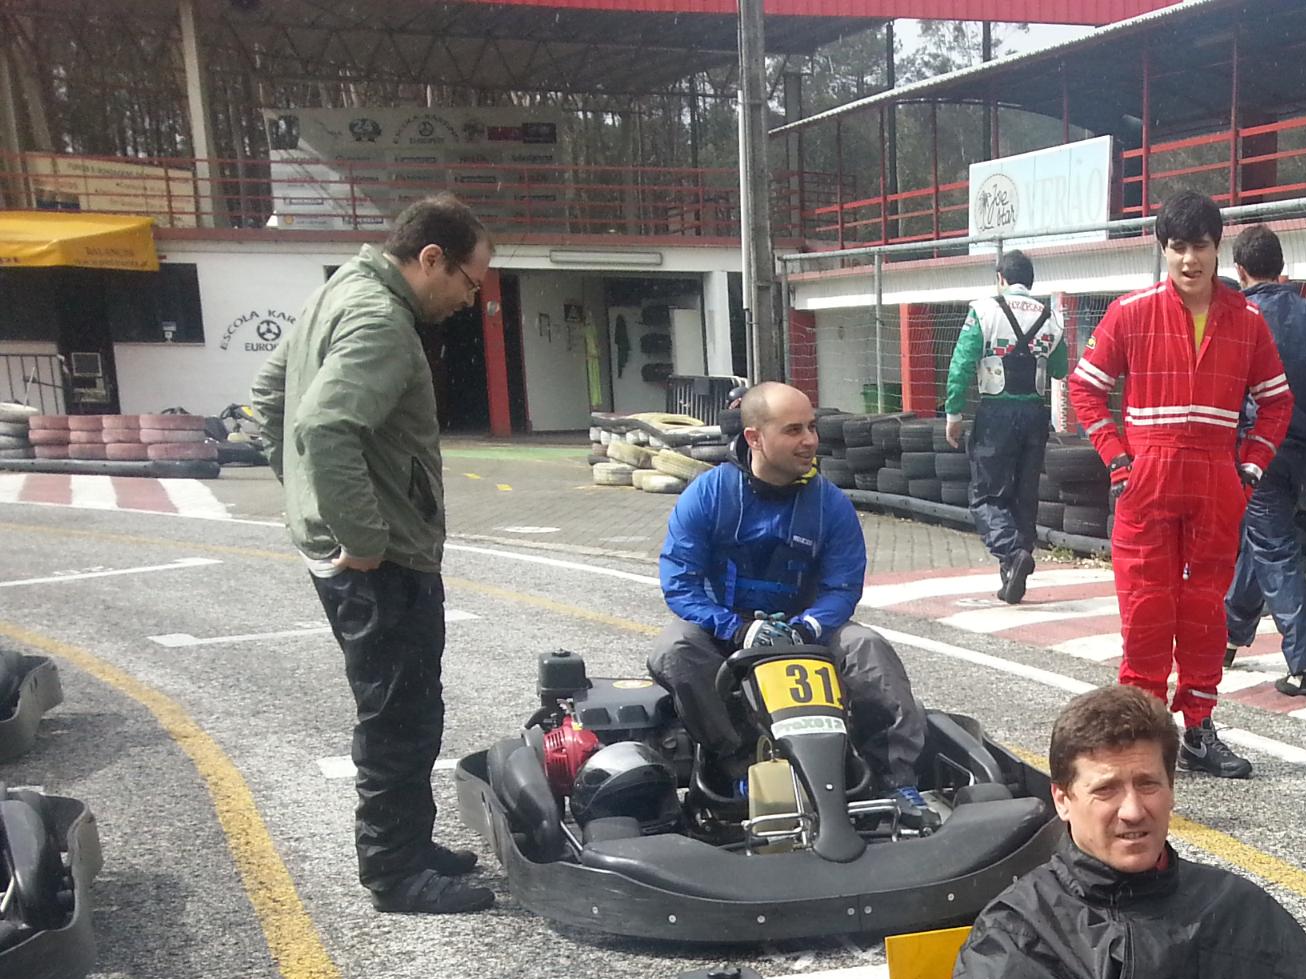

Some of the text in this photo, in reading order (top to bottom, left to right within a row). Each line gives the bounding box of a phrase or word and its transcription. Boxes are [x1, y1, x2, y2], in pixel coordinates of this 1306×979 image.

[220, 309, 297, 351] ESCOLA KAR
[785, 663, 835, 705] 31
